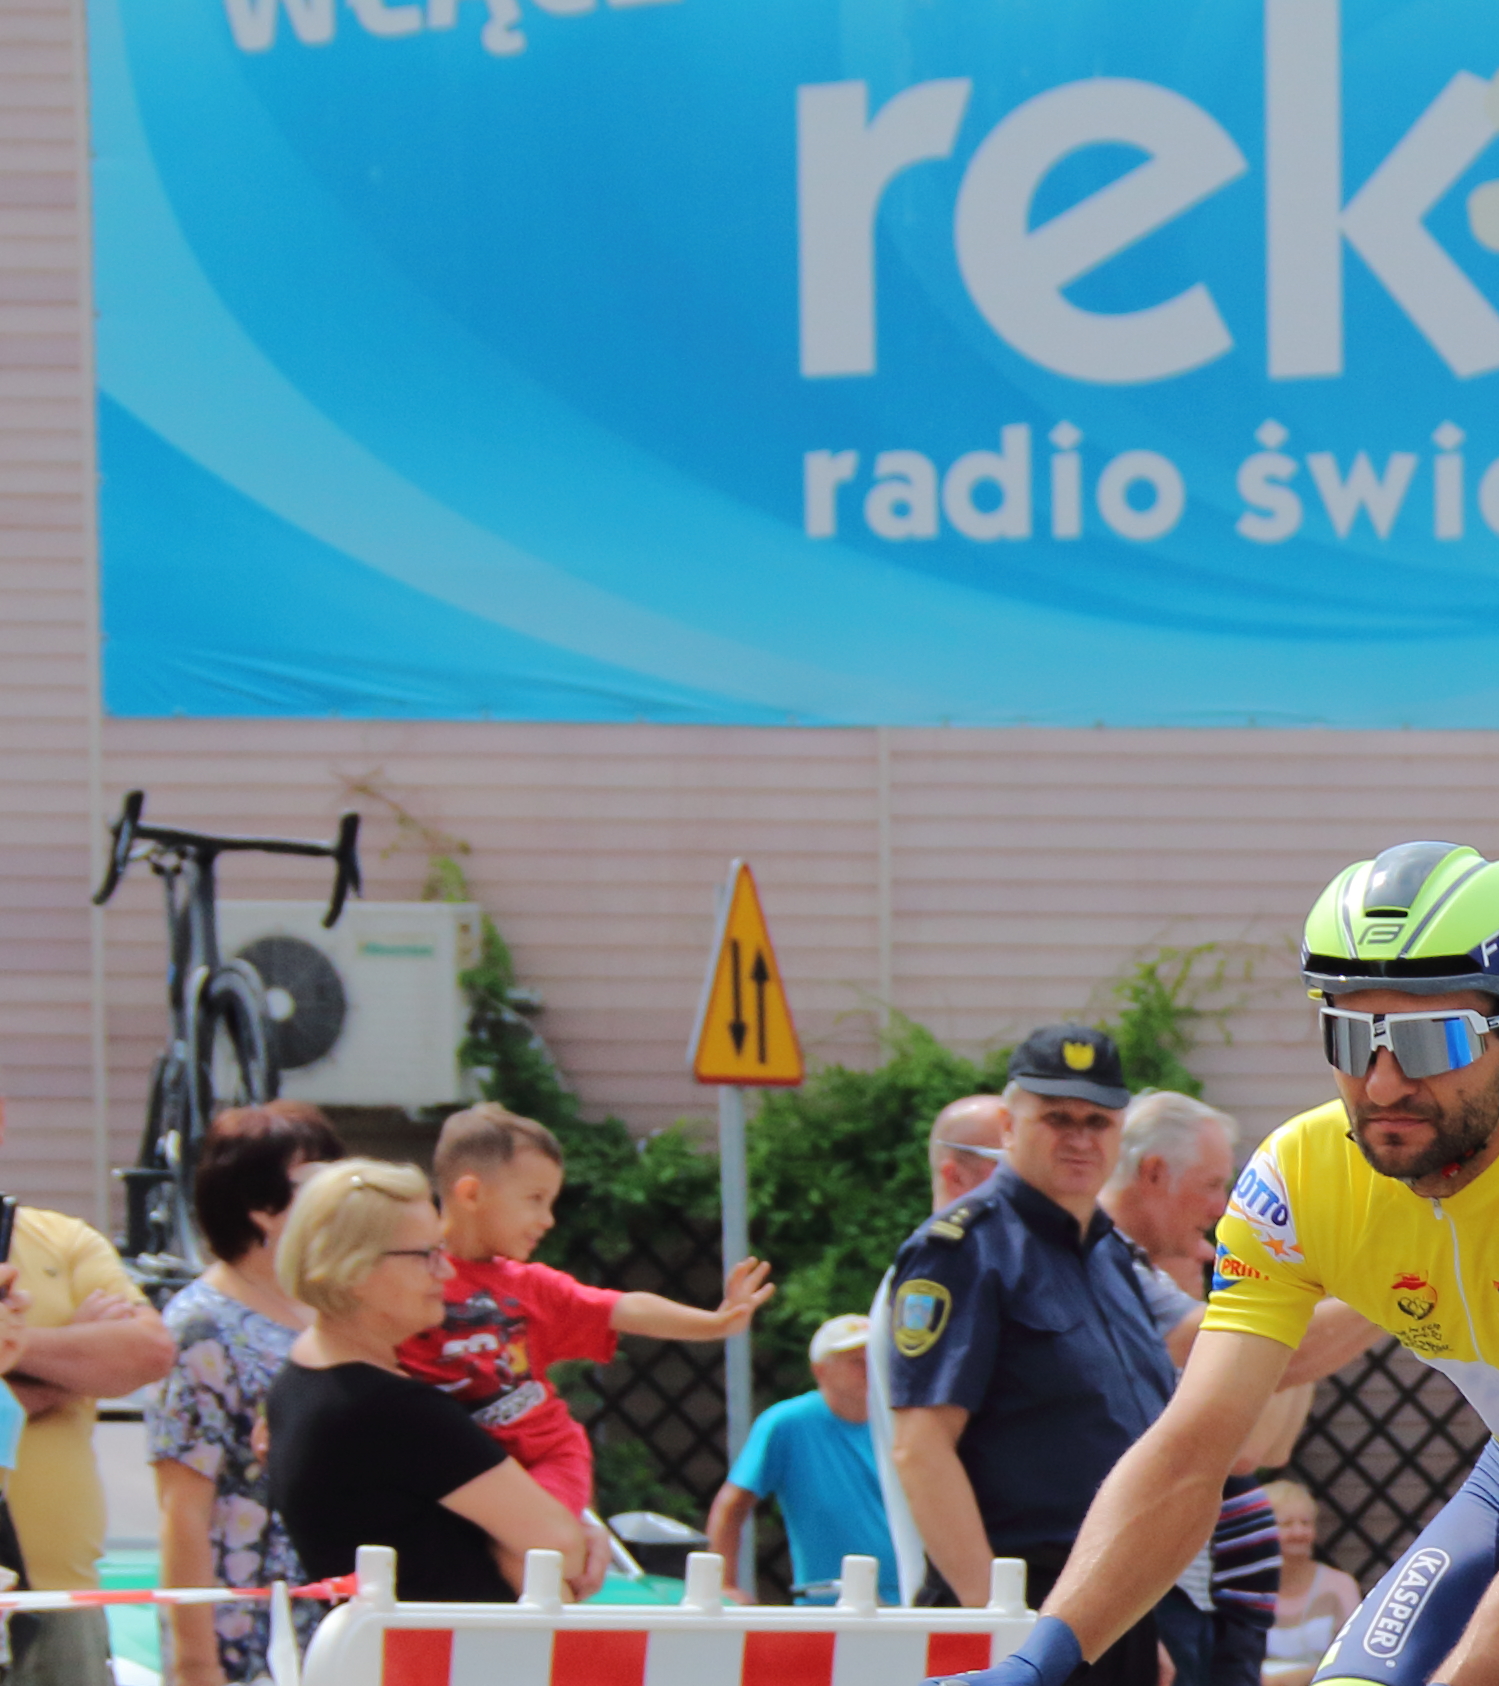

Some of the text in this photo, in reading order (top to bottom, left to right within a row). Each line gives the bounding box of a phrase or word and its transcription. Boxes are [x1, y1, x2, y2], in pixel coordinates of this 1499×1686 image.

[805, 425, 1186, 541] radio
[1236, 1167, 1289, 1227] OTTO
[1370, 1555, 1442, 1649] KASPER
